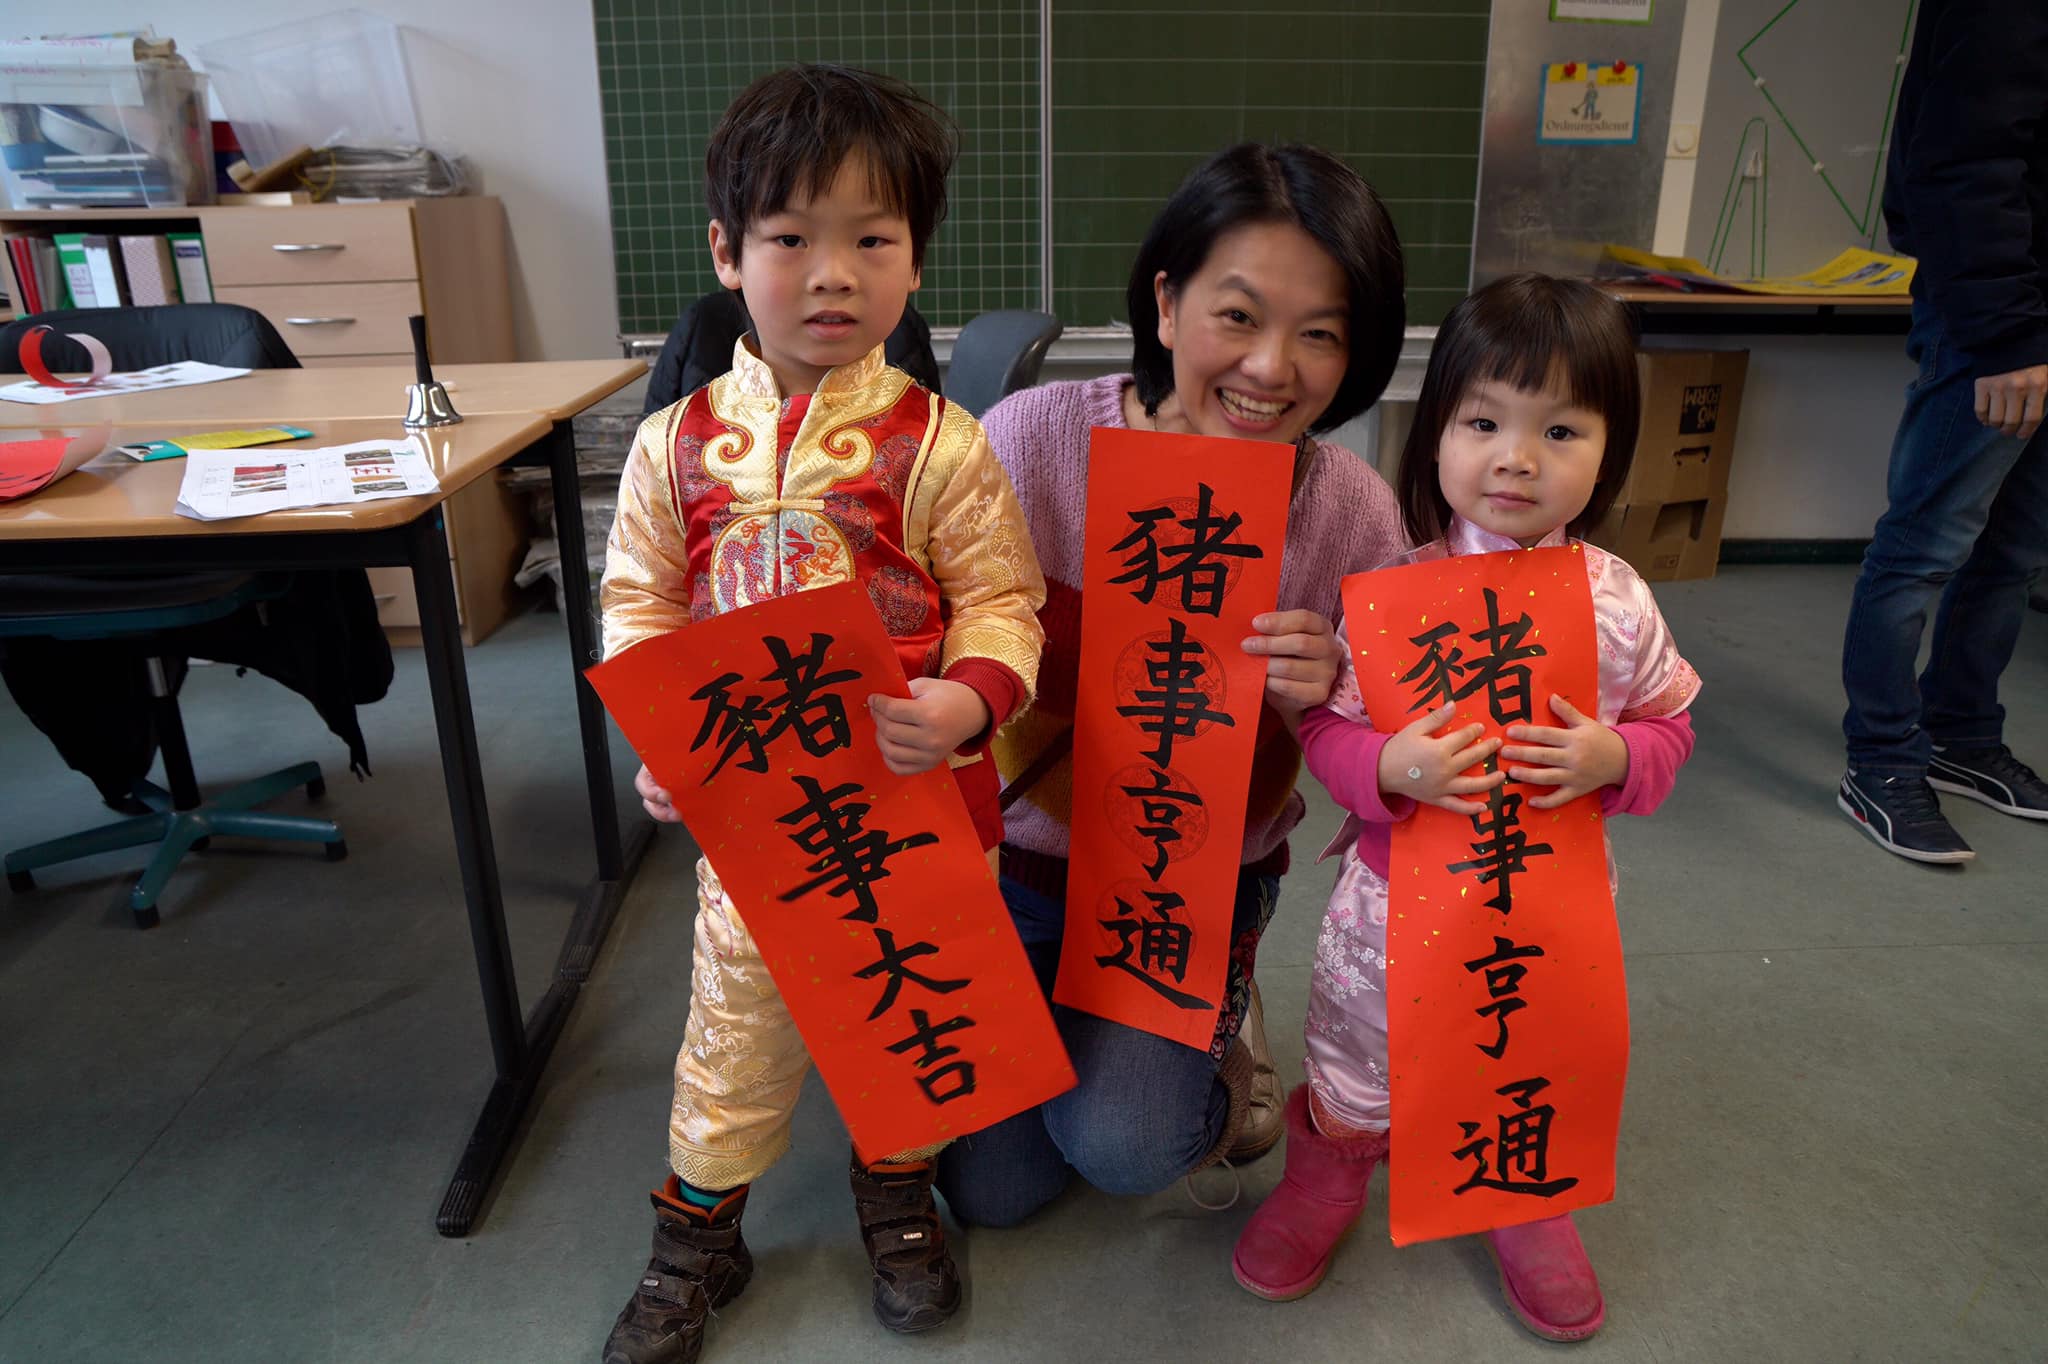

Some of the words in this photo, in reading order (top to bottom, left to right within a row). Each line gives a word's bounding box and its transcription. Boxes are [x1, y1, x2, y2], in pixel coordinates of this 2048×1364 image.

[688, 632, 976, 1105] 豬事大吉
[1094, 482, 1264, 1011] 豬事亨通
[1396, 587, 1579, 1198] 豬事亨通
